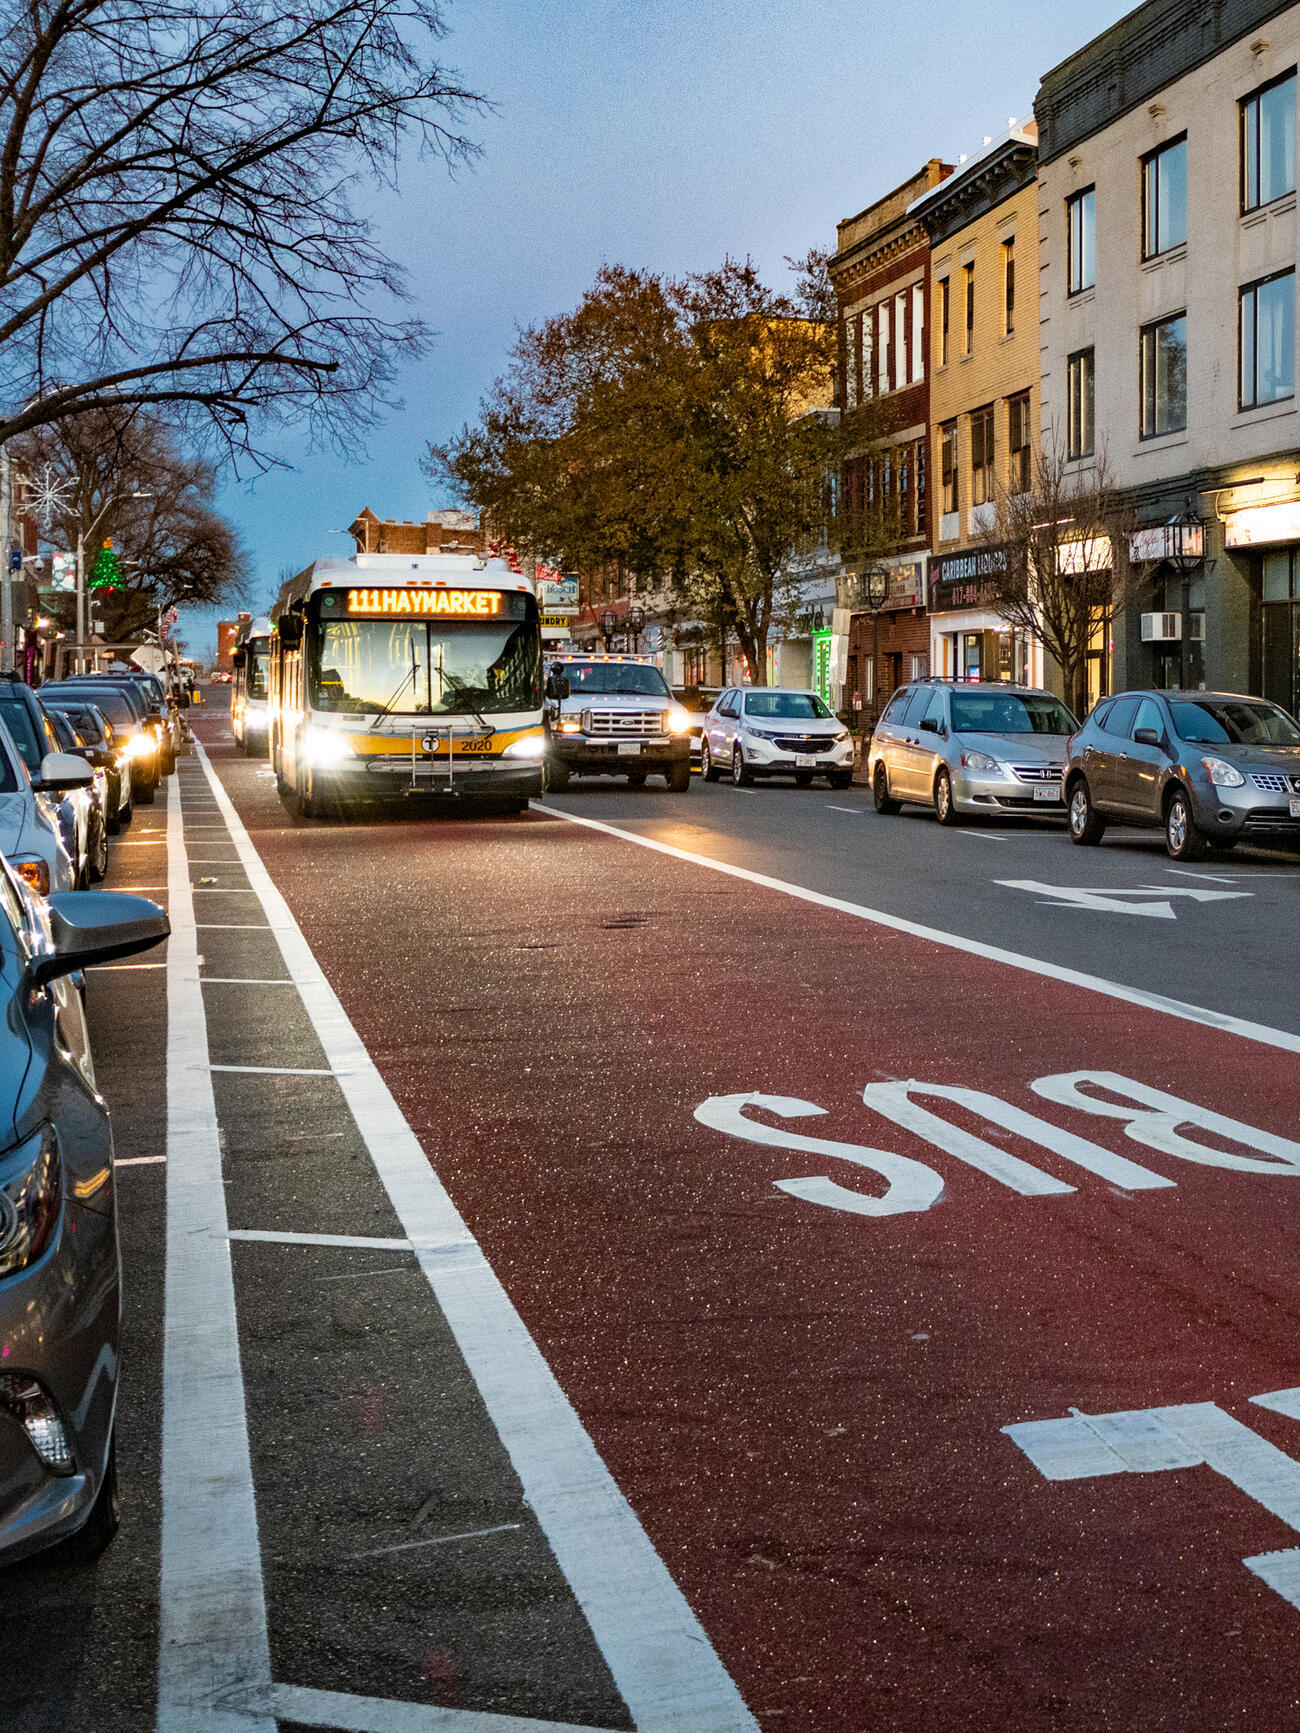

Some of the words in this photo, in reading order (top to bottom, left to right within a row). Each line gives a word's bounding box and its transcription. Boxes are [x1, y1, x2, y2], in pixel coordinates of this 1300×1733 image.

[941, 556, 977, 582] CARIBBEAN
[348, 590, 381, 612] 111
[382, 591, 502, 613] HAYMARKET
[461, 740, 492, 751] 2020
